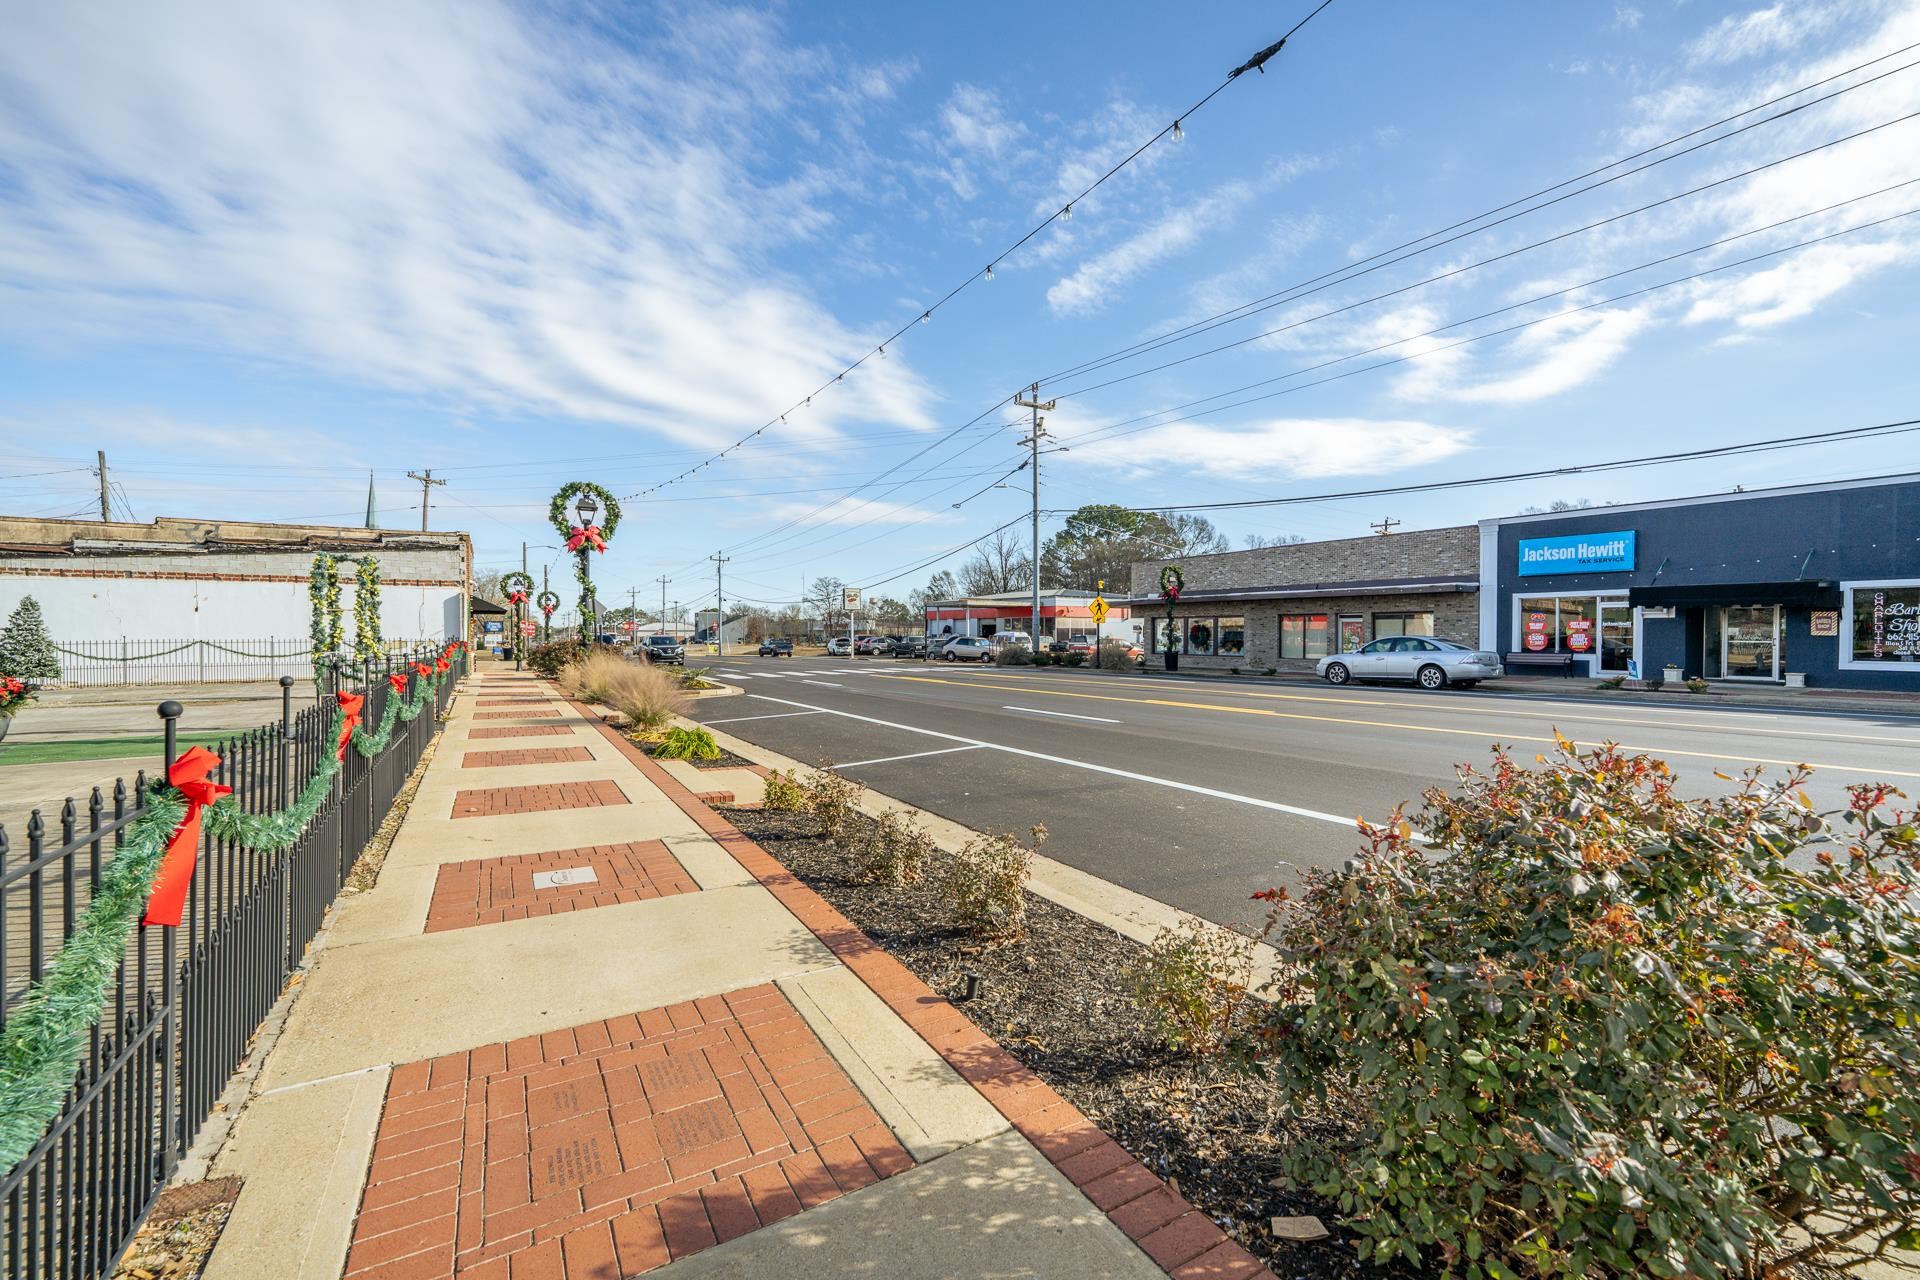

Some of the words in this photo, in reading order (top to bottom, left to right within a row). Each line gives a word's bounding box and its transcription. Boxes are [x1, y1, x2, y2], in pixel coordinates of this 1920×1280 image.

[1523, 547, 1575, 562] Jackson
[1578, 540, 1625, 558] Hewitt
[1594, 556, 1625, 564] SERVICE
